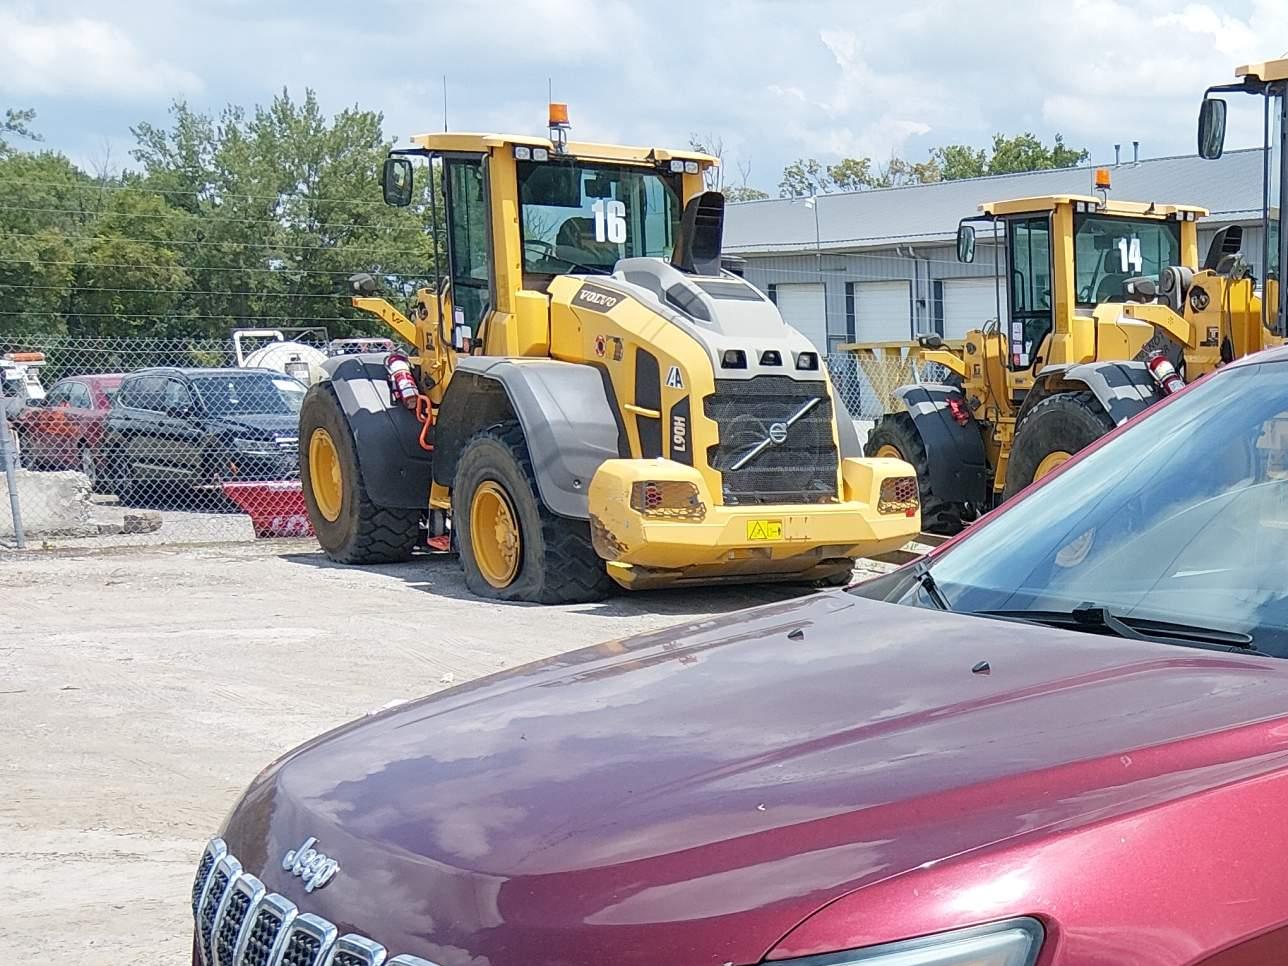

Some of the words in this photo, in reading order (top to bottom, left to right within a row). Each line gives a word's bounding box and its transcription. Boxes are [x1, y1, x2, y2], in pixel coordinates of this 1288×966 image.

[592, 199, 627, 243] 16
[1118, 237, 1143, 273] 14
[579, 288, 617, 308] VOLVO
[673, 415, 686, 452] L90H
[282, 836, 341, 893] Jeep
